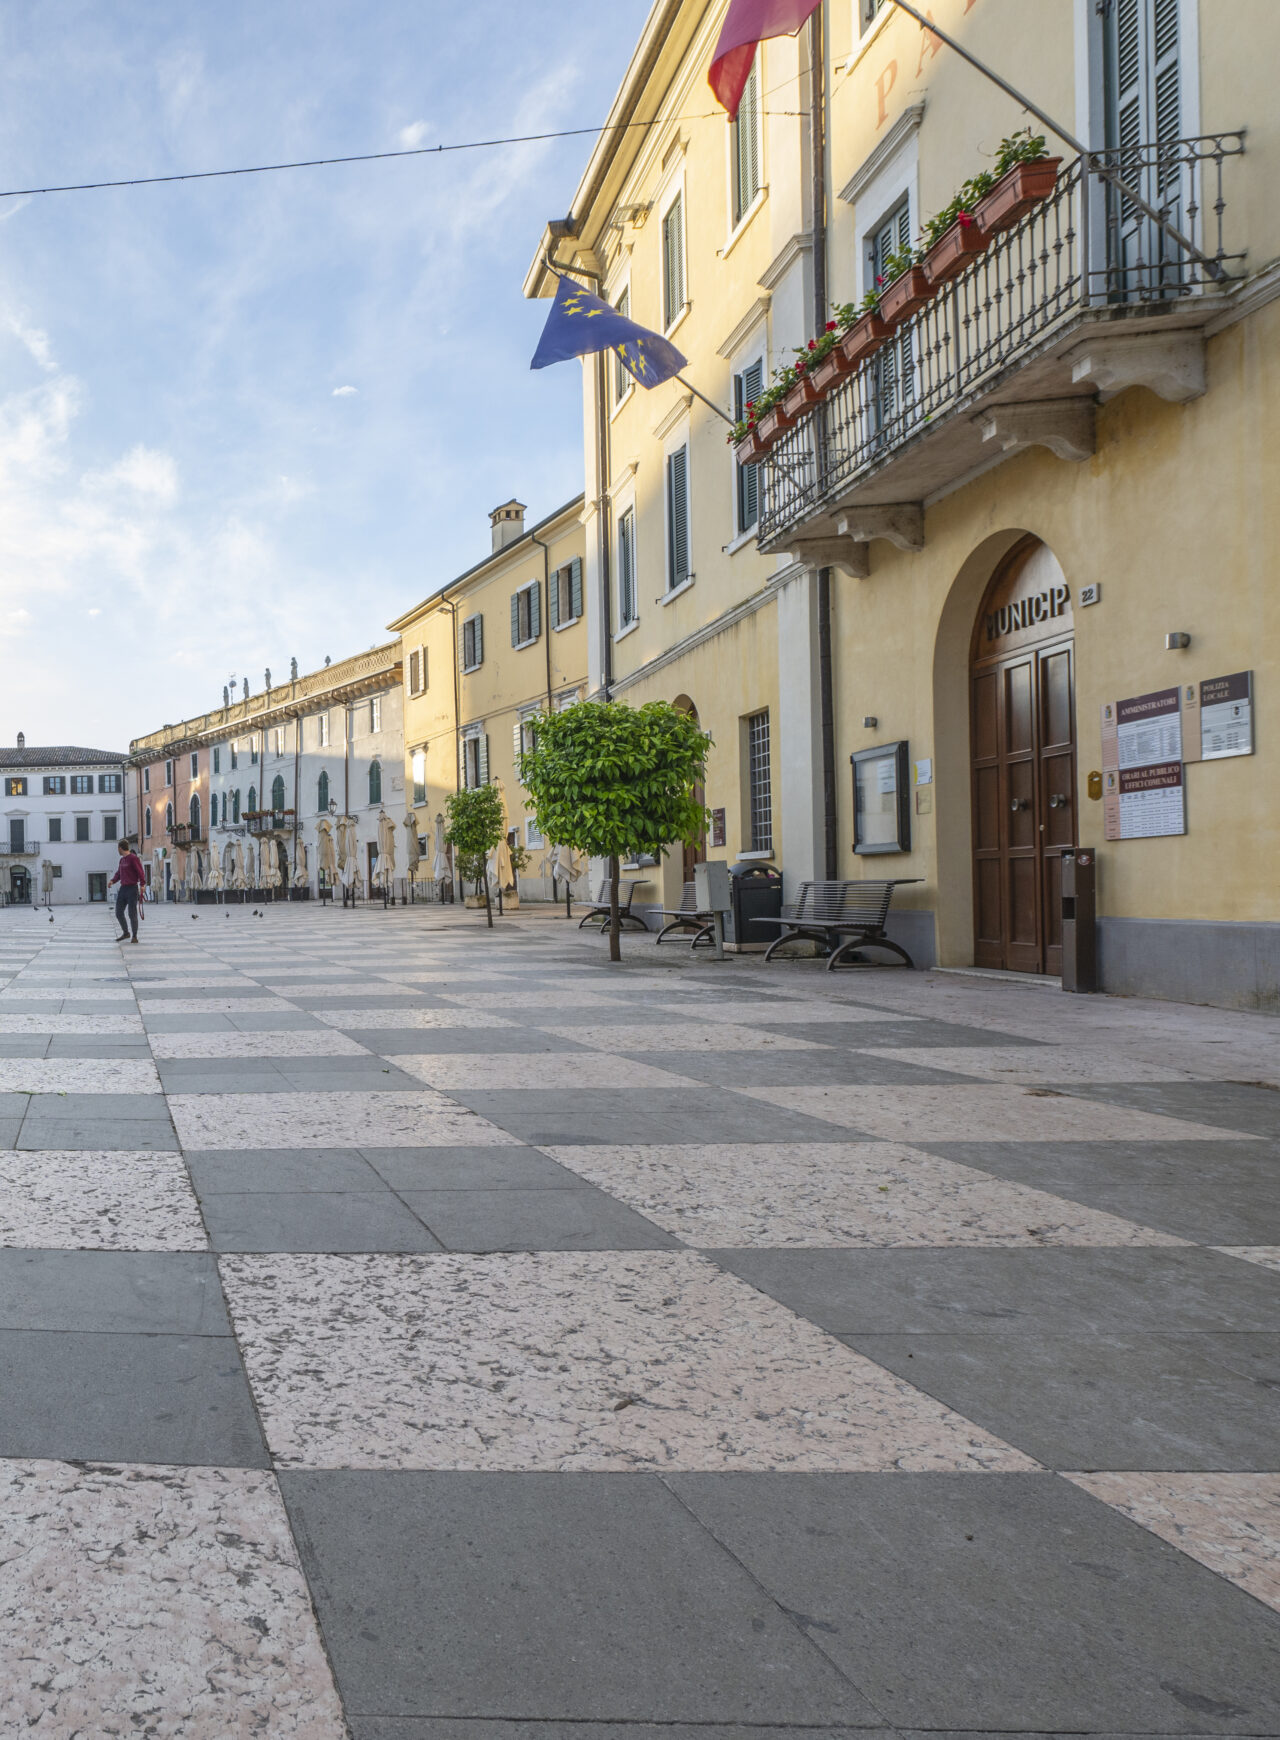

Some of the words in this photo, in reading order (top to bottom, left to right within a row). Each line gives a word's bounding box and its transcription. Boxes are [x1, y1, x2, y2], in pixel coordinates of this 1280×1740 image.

[1082, 588, 1094, 602] 22
[1203, 681, 1230, 692] POLIZIA
[1203, 690, 1230, 701] LOCALE
[1121, 697, 1176, 716] AMMINISTRATORI
[1149, 765, 1180, 777] PUBBLICO
[1124, 780, 1143, 790] UFFICI
